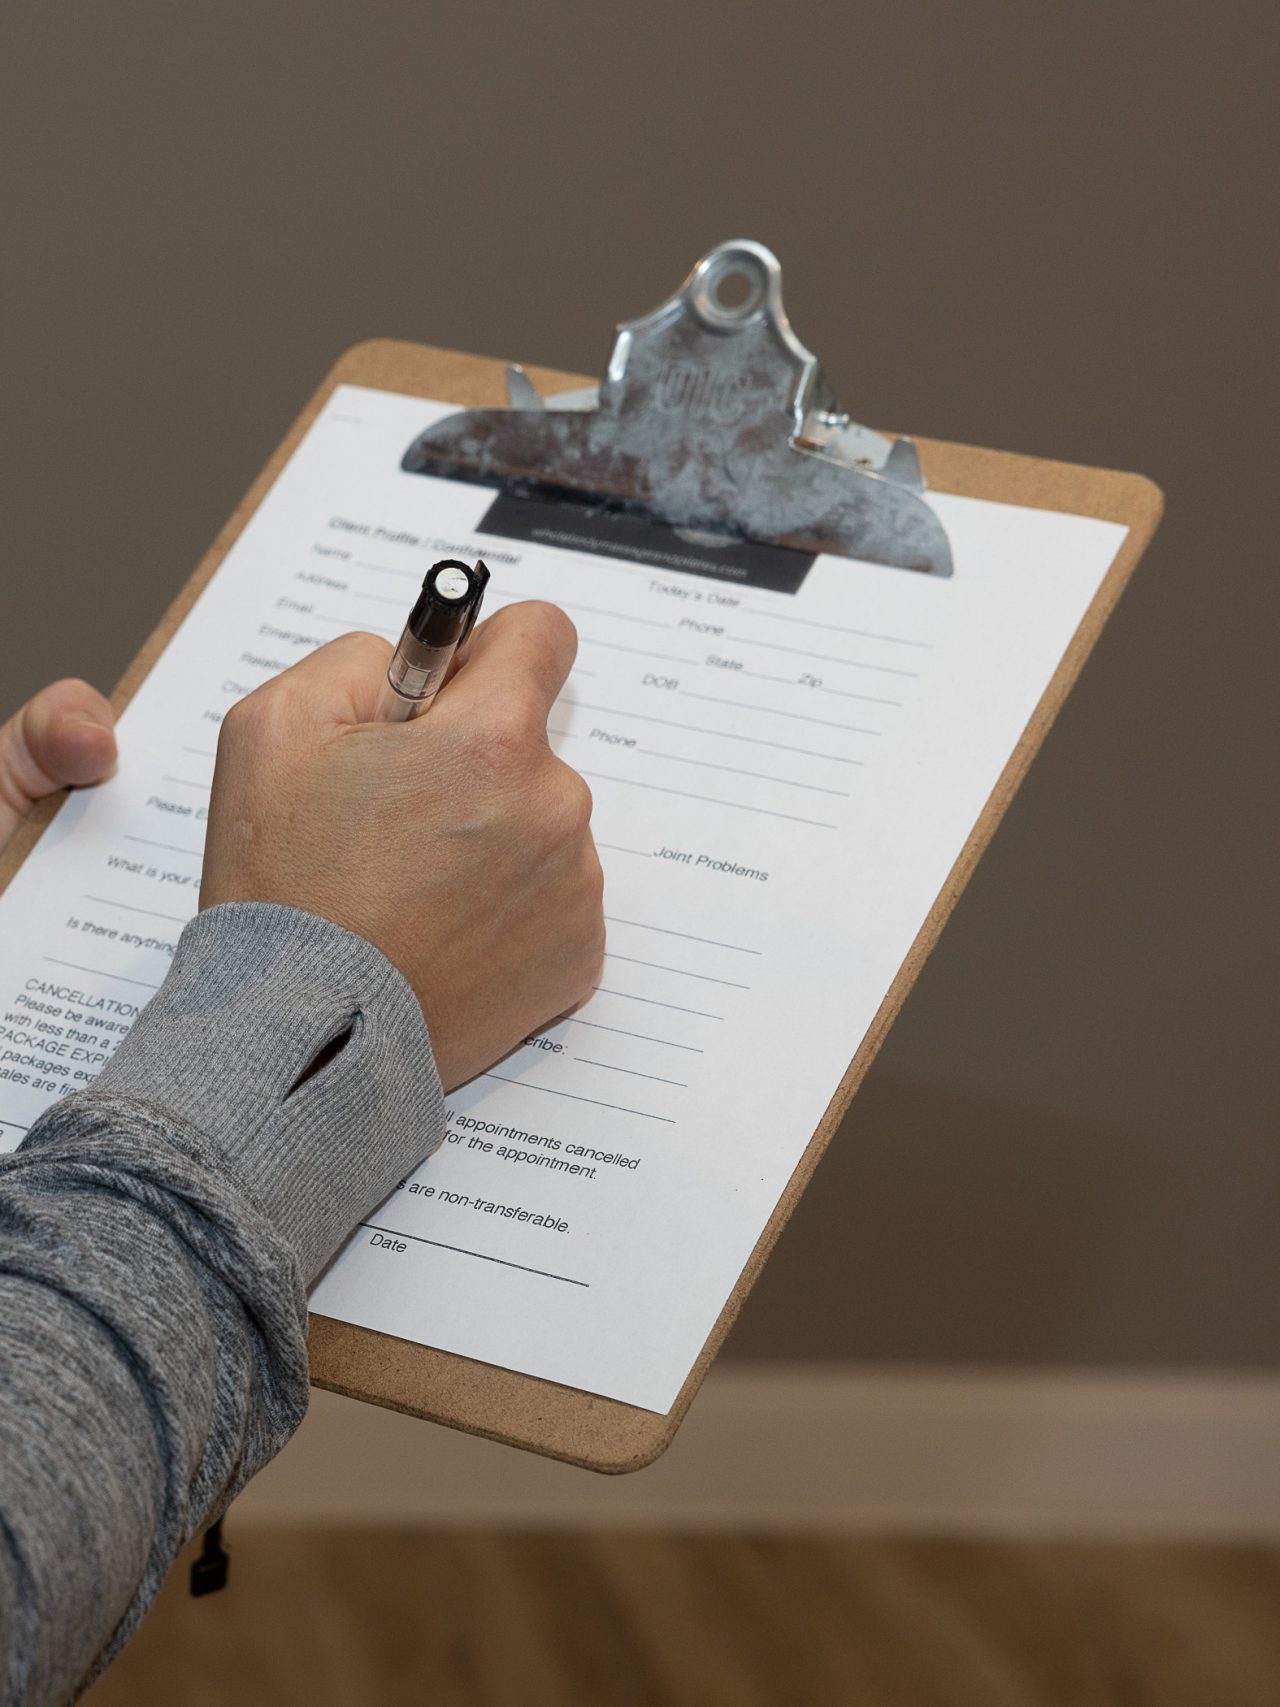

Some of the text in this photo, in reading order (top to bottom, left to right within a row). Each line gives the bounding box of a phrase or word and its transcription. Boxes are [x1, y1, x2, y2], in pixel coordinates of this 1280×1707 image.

[328, 516, 371, 536] Client
[373, 526, 420, 547] Profile
[432, 539, 520, 564] Confidential
[312, 544, 352, 560] Name
[295, 570, 349, 591] Address
[276, 597, 314, 614] Email
[649, 581, 740, 608] Today's Date
[678, 617, 725, 636] Phone
[641, 673, 679, 691] DOB
[705, 654, 823, 690] State Zip
[589, 728, 637, 748] Phone
[147, 795, 193, 817] Please
[107, 855, 144, 875] What
[146, 867, 157, 878] is
[160, 870, 192, 886] your
[653, 846, 769, 882] Joint Problems
[67, 917, 79, 929] Is
[81, 922, 119, 939] there
[14, 994, 130, 1034] Please be aware
[4, 1011, 31, 1028] with
[33, 1018, 63, 1036] less
[65, 1027, 98, 1045] than
[99, 1038, 111, 1049] a
[523, 1035, 569, 1055] cribe:
[1, 1050, 70, 1077] packages
[71, 1050, 109, 1067] EXPI
[32, 1077, 57, 1092] are
[456, 1112, 562, 1151] appointments
[565, 1143, 641, 1170] cancelled
[443, 1129, 597, 1180] for the appointment.
[408, 1181, 571, 1235] are non-transferable.
[369, 1233, 408, 1253] Date
